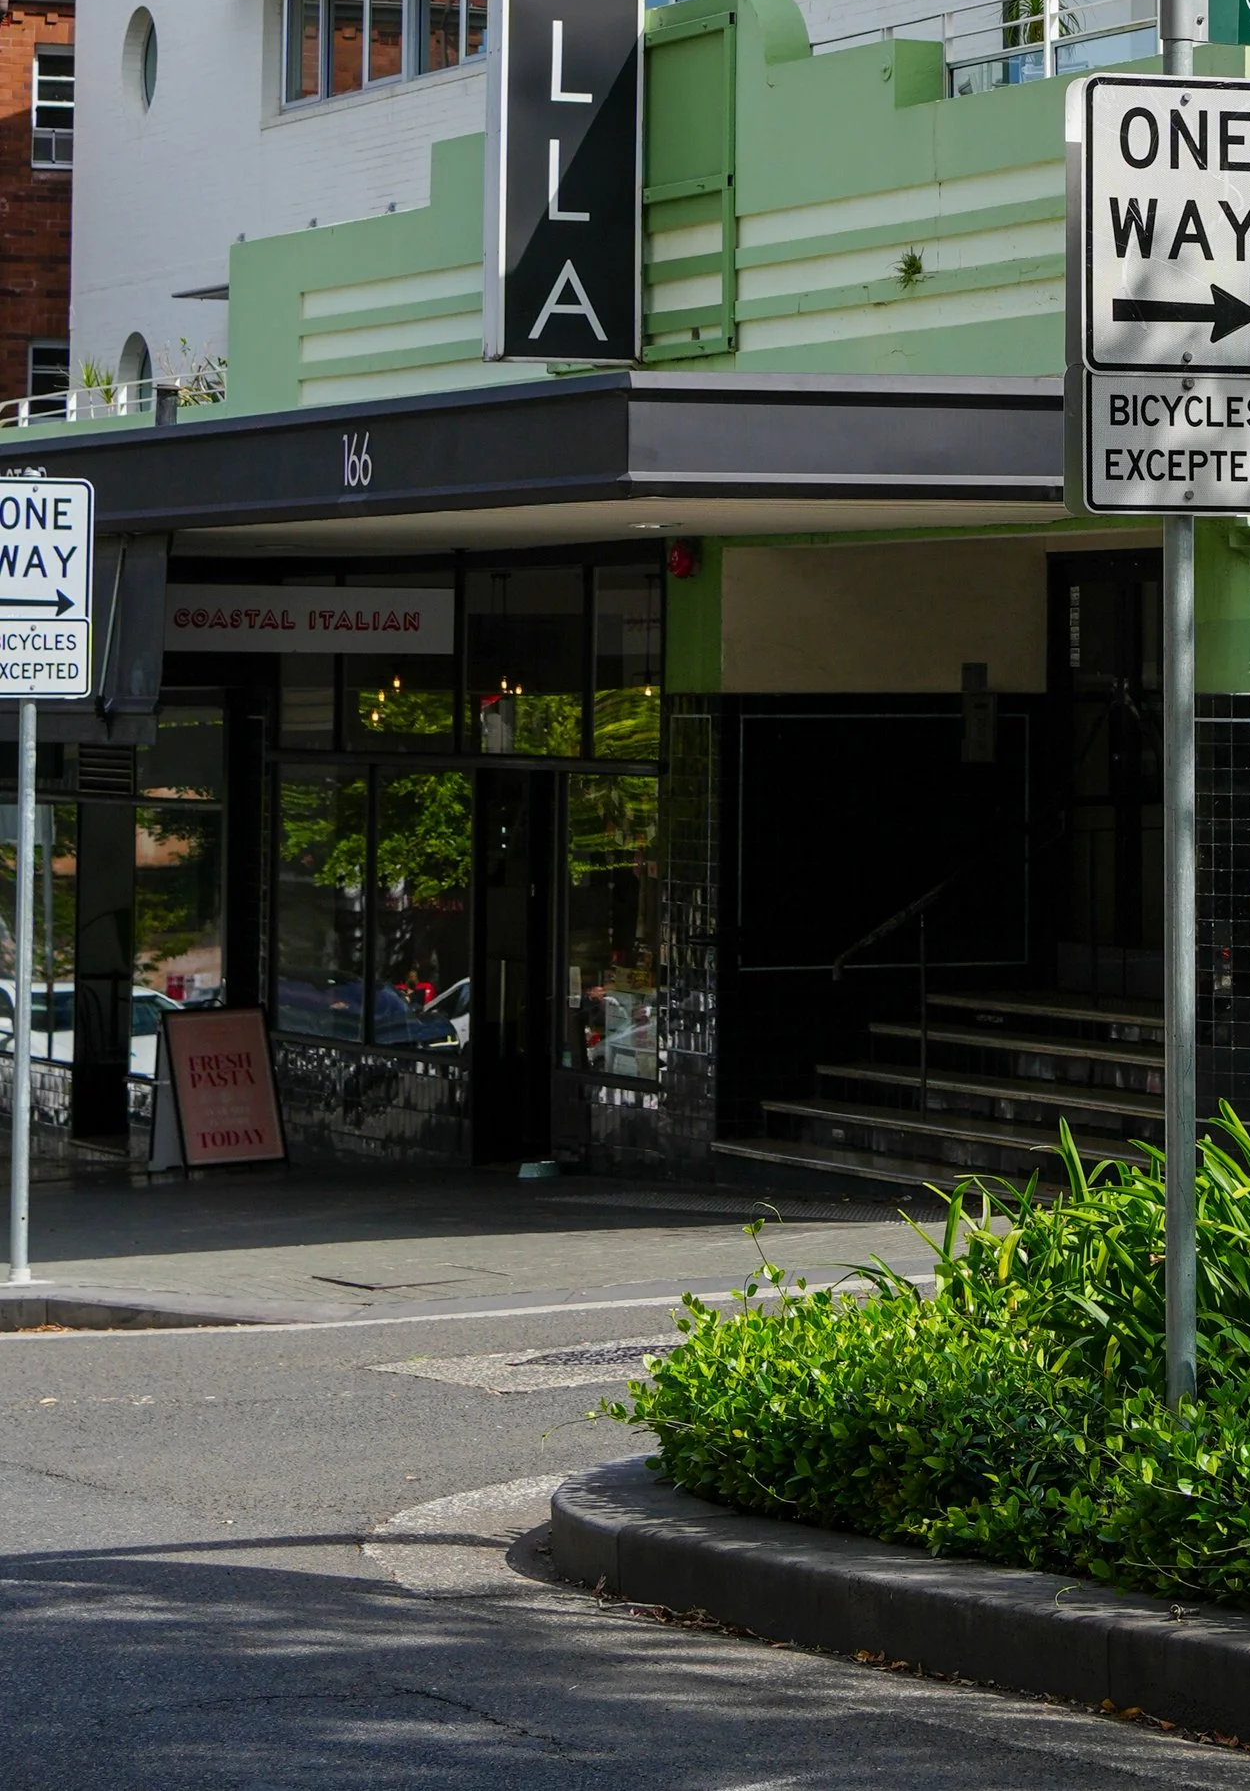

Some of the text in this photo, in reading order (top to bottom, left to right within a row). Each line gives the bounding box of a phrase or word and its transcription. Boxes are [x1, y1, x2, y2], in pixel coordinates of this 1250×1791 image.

[342, 431, 372, 487] 166
[0, 496, 72, 531] ONE
[0, 545, 77, 579] WAY
[173, 608, 421, 632] COASTAL ITALIAN
[0, 662, 79, 680] XCEPTED
[188, 1052, 253, 1072] FRESH
[190, 1069, 256, 1089] PASTA
[197, 1128, 267, 1149] TODAY
